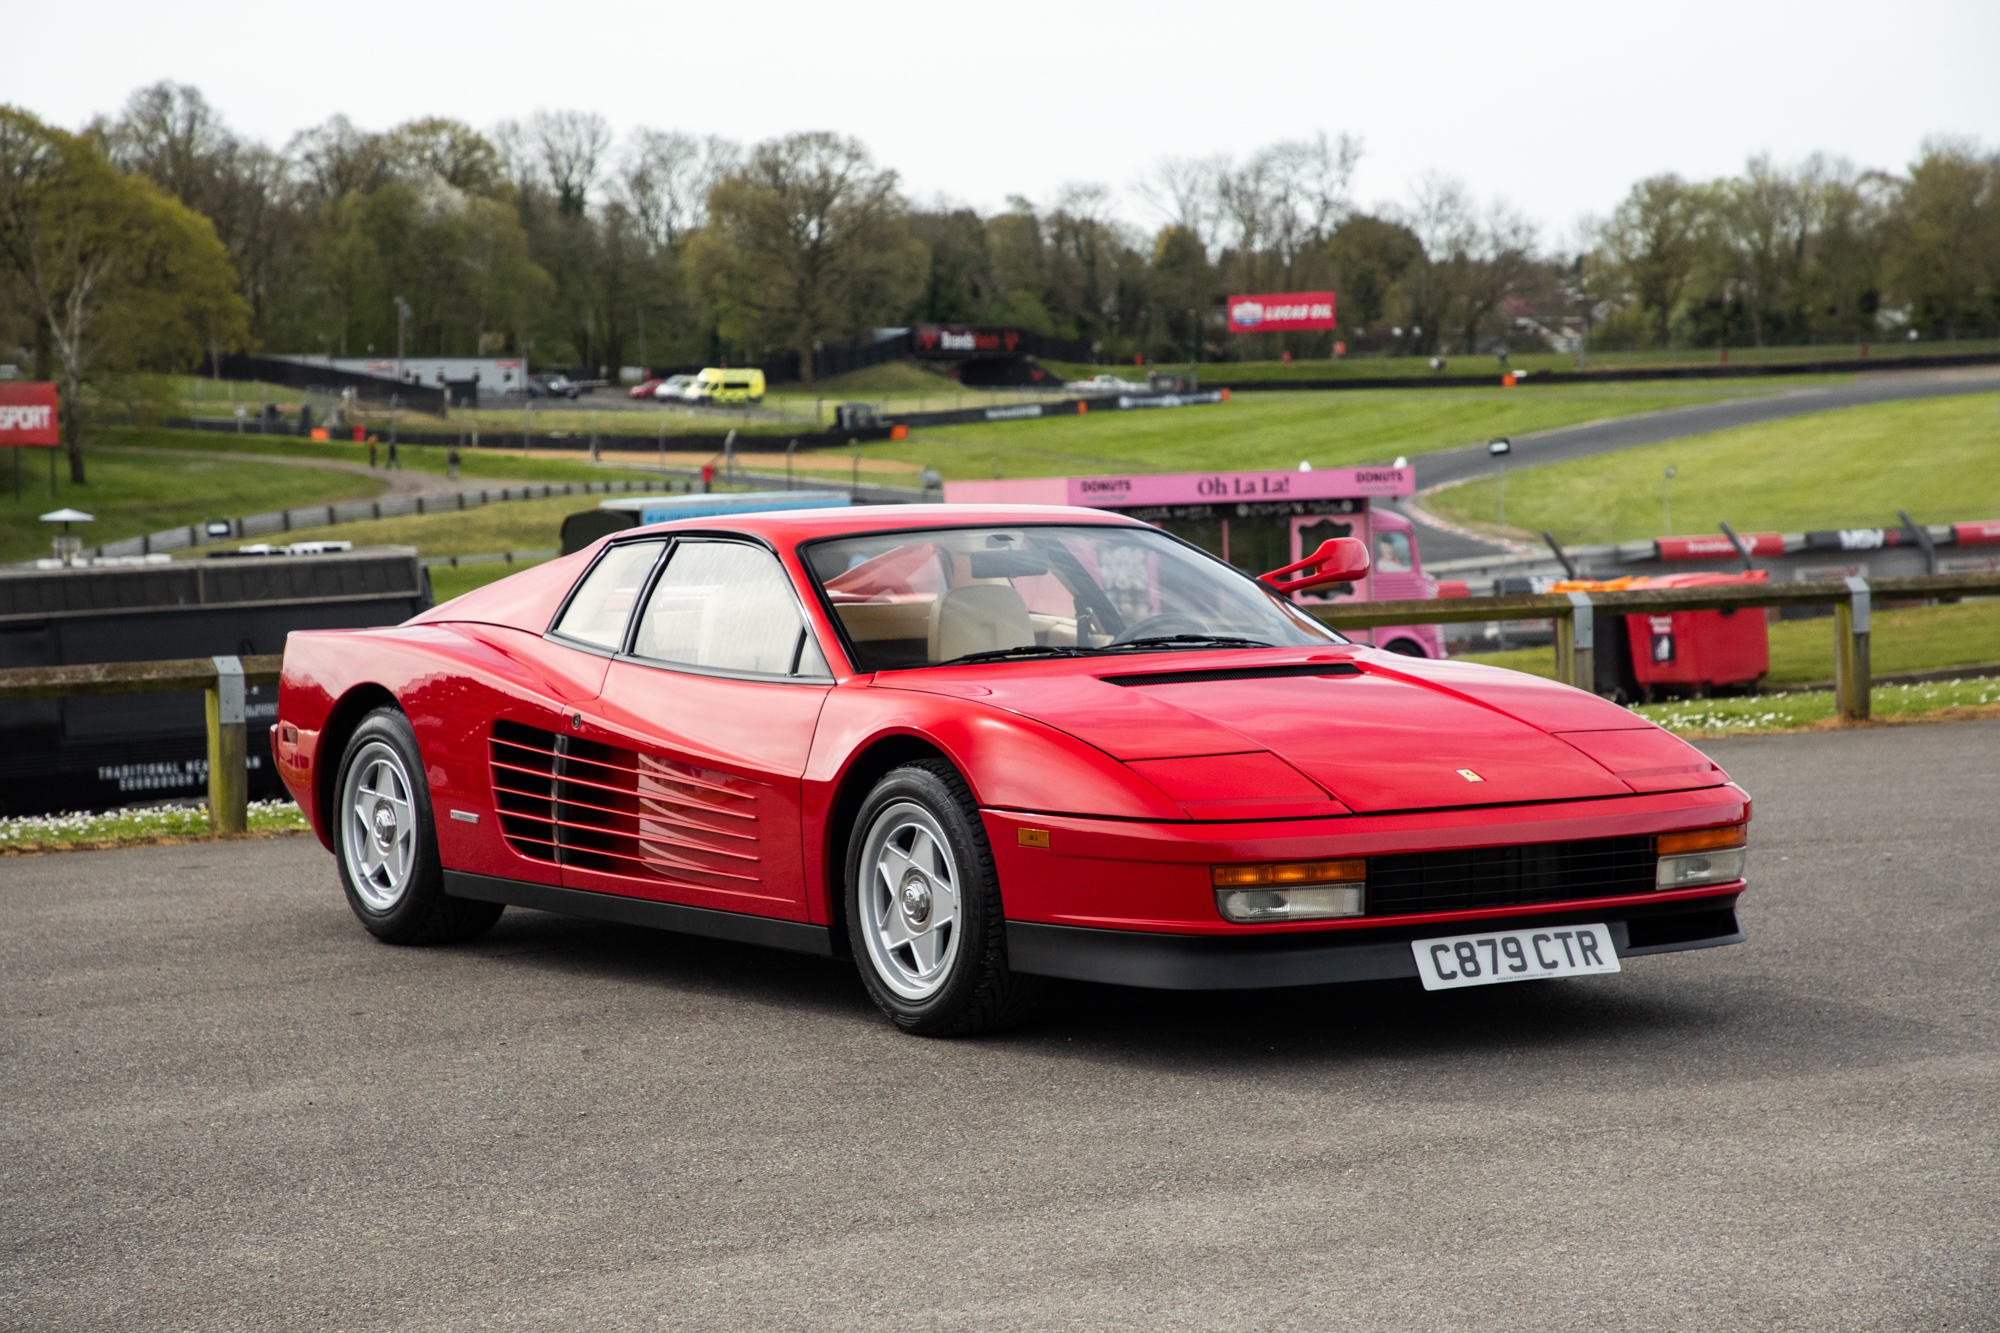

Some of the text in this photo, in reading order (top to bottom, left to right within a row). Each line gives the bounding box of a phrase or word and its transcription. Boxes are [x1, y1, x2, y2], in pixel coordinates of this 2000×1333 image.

[1309, 303, 1332, 320] OIL
[1081, 480, 1131, 492] DONUTS
[1198, 477, 1289, 496] Oh La La!
[1356, 471, 1403, 483] DONUTS
[98, 761, 181, 780] TRADITIONAL
[119, 772, 194, 791] SOURDOUGH
[1430, 930, 1604, 981] C879 CTR
